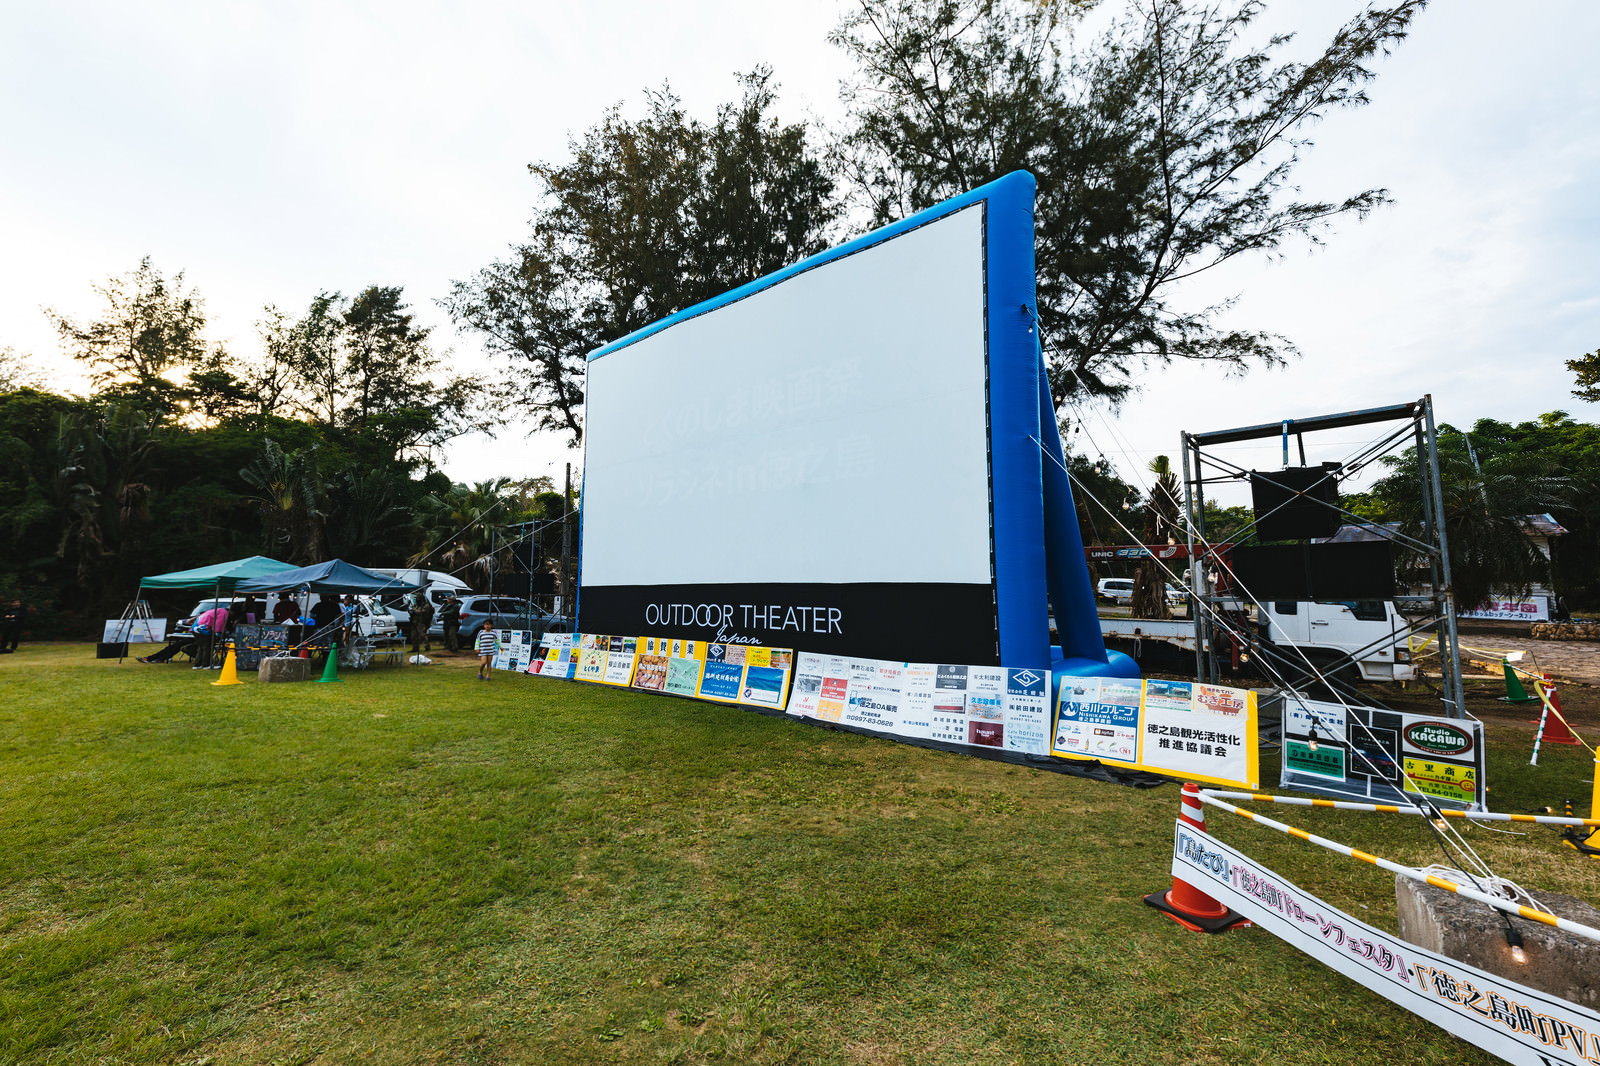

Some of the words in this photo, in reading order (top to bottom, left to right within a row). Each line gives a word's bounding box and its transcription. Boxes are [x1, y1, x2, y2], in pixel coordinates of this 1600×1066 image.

[645, 603, 734, 628] OUTDOOR
[739, 604, 843, 635] THEATER
[714, 624, 763, 645] Japan
[1079, 703, 1137, 716] 西川グループ
[1197, 694, 1244, 709] むぎ工房
[1147, 723, 1241, 746] 徳之島観光活性化
[1411, 731, 1465, 747] KAGAWA
[1423, 727, 1450, 736] Studio
[1158, 737, 1227, 757] 推進協議会
